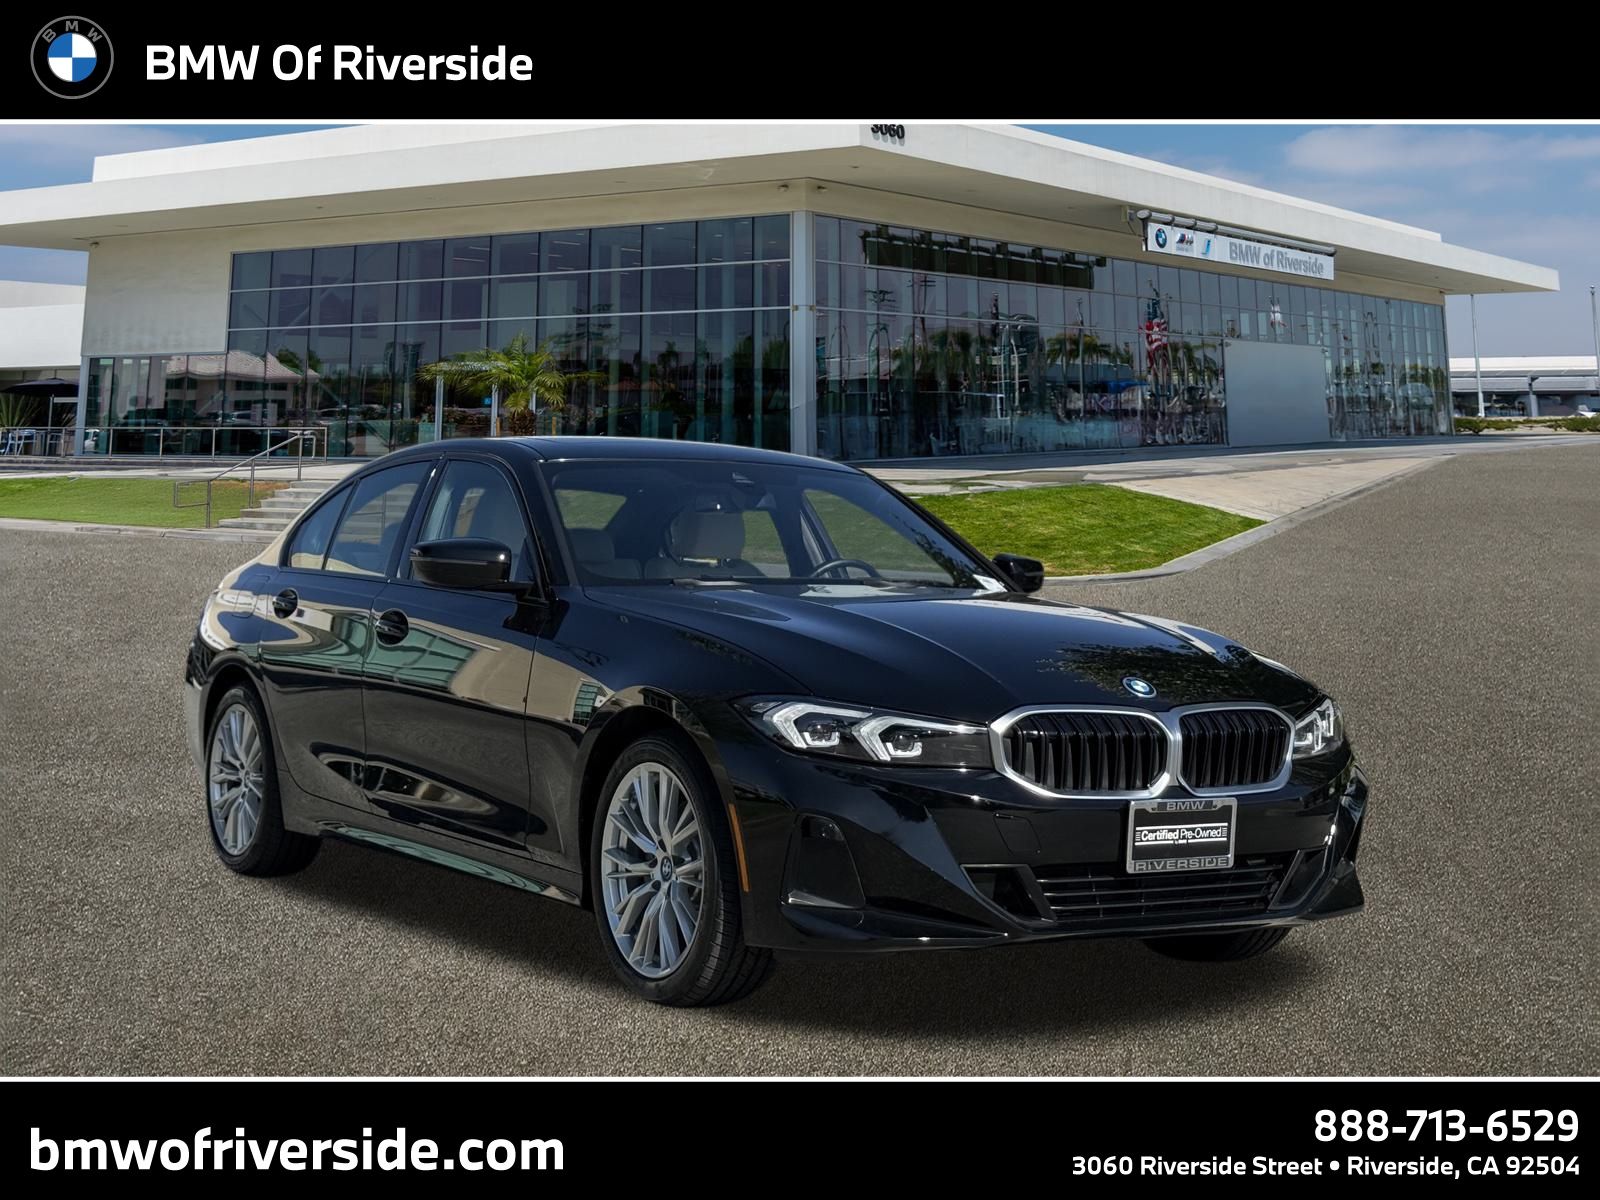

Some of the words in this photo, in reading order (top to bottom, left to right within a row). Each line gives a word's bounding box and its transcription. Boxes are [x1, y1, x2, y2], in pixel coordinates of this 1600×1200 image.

[1229, 241, 1261, 265] BMW
[1262, 249, 1275, 267] of
[1276, 250, 1324, 275] Riverside
[1166, 801, 1206, 811] BMW
[1141, 829, 1180, 841] Certified
[1180, 827, 1222, 839] Pre-Owned
[1135, 857, 1228, 872] RIVERSIDE
